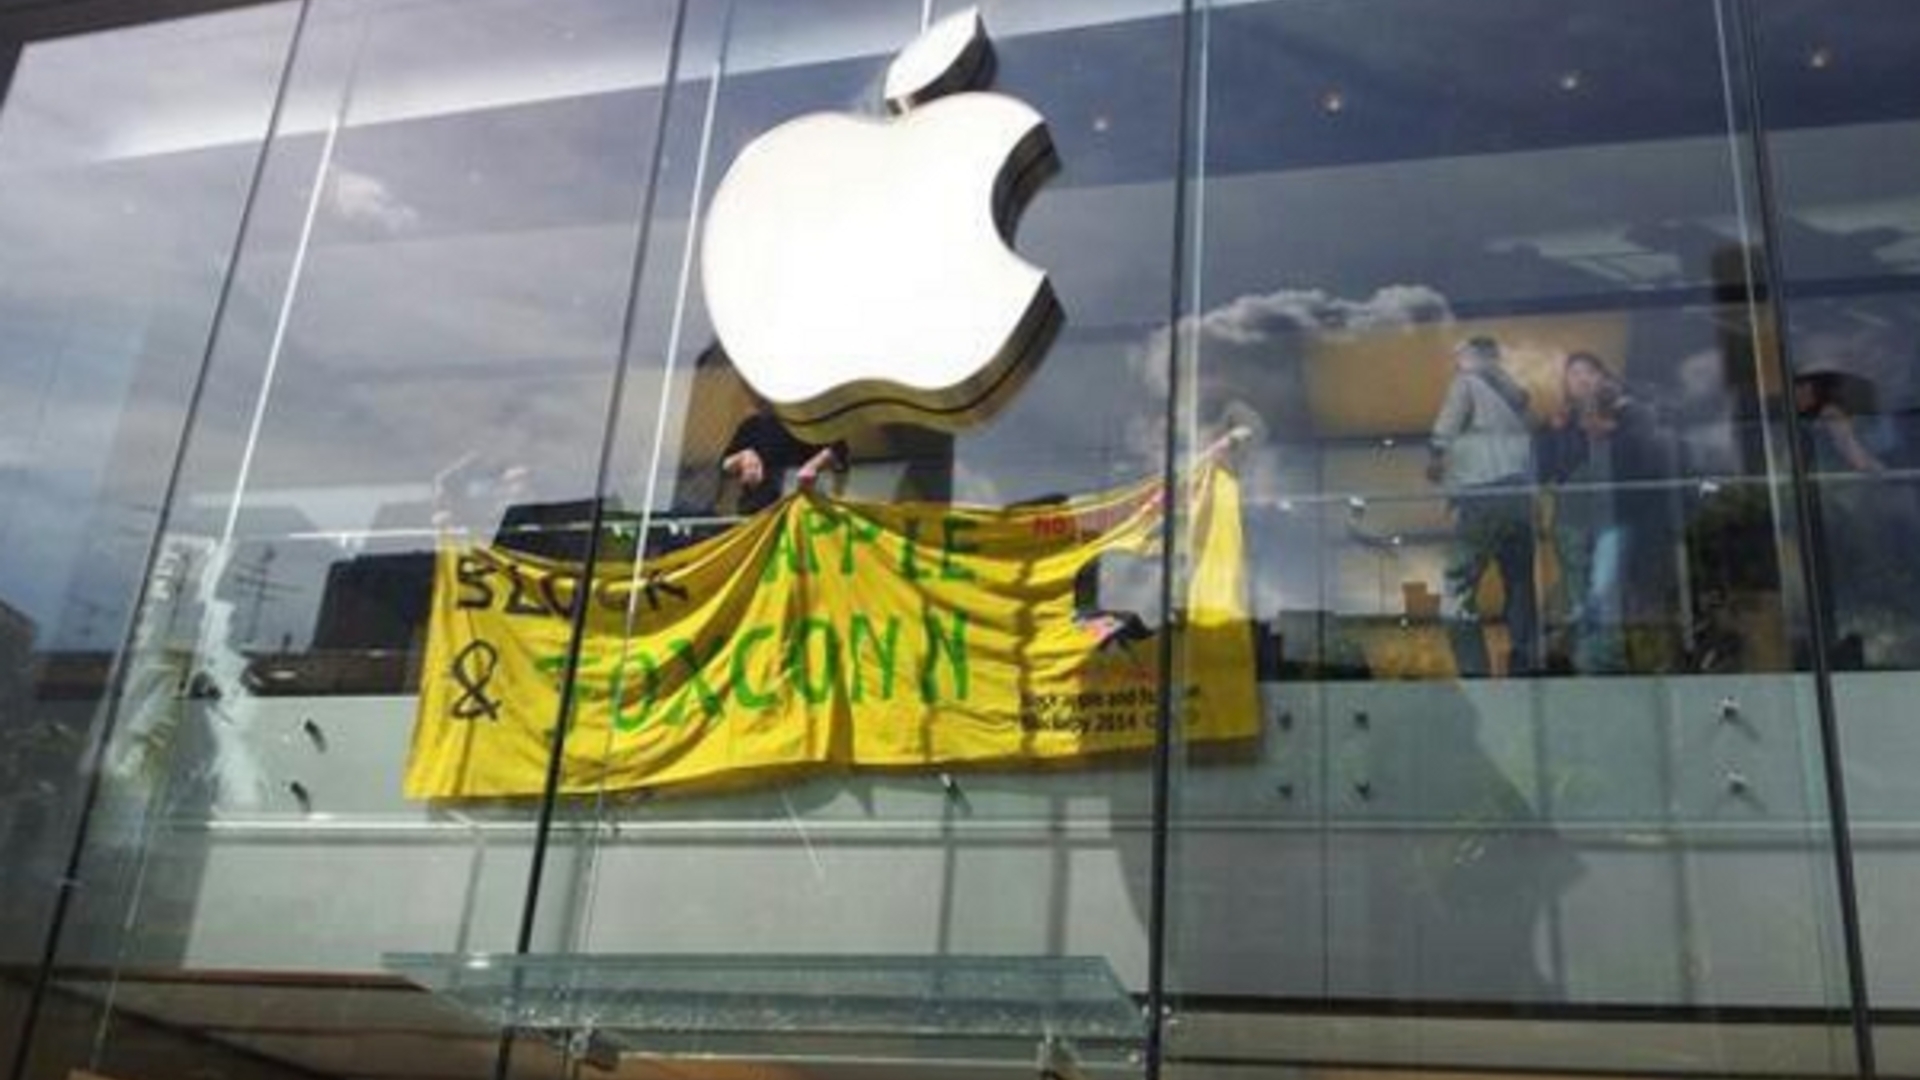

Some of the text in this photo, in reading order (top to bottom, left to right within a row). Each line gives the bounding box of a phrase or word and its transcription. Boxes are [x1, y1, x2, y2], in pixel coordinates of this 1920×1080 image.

[762, 508, 977, 583] APPLE
[450, 606, 969, 738] & FOXCONN
